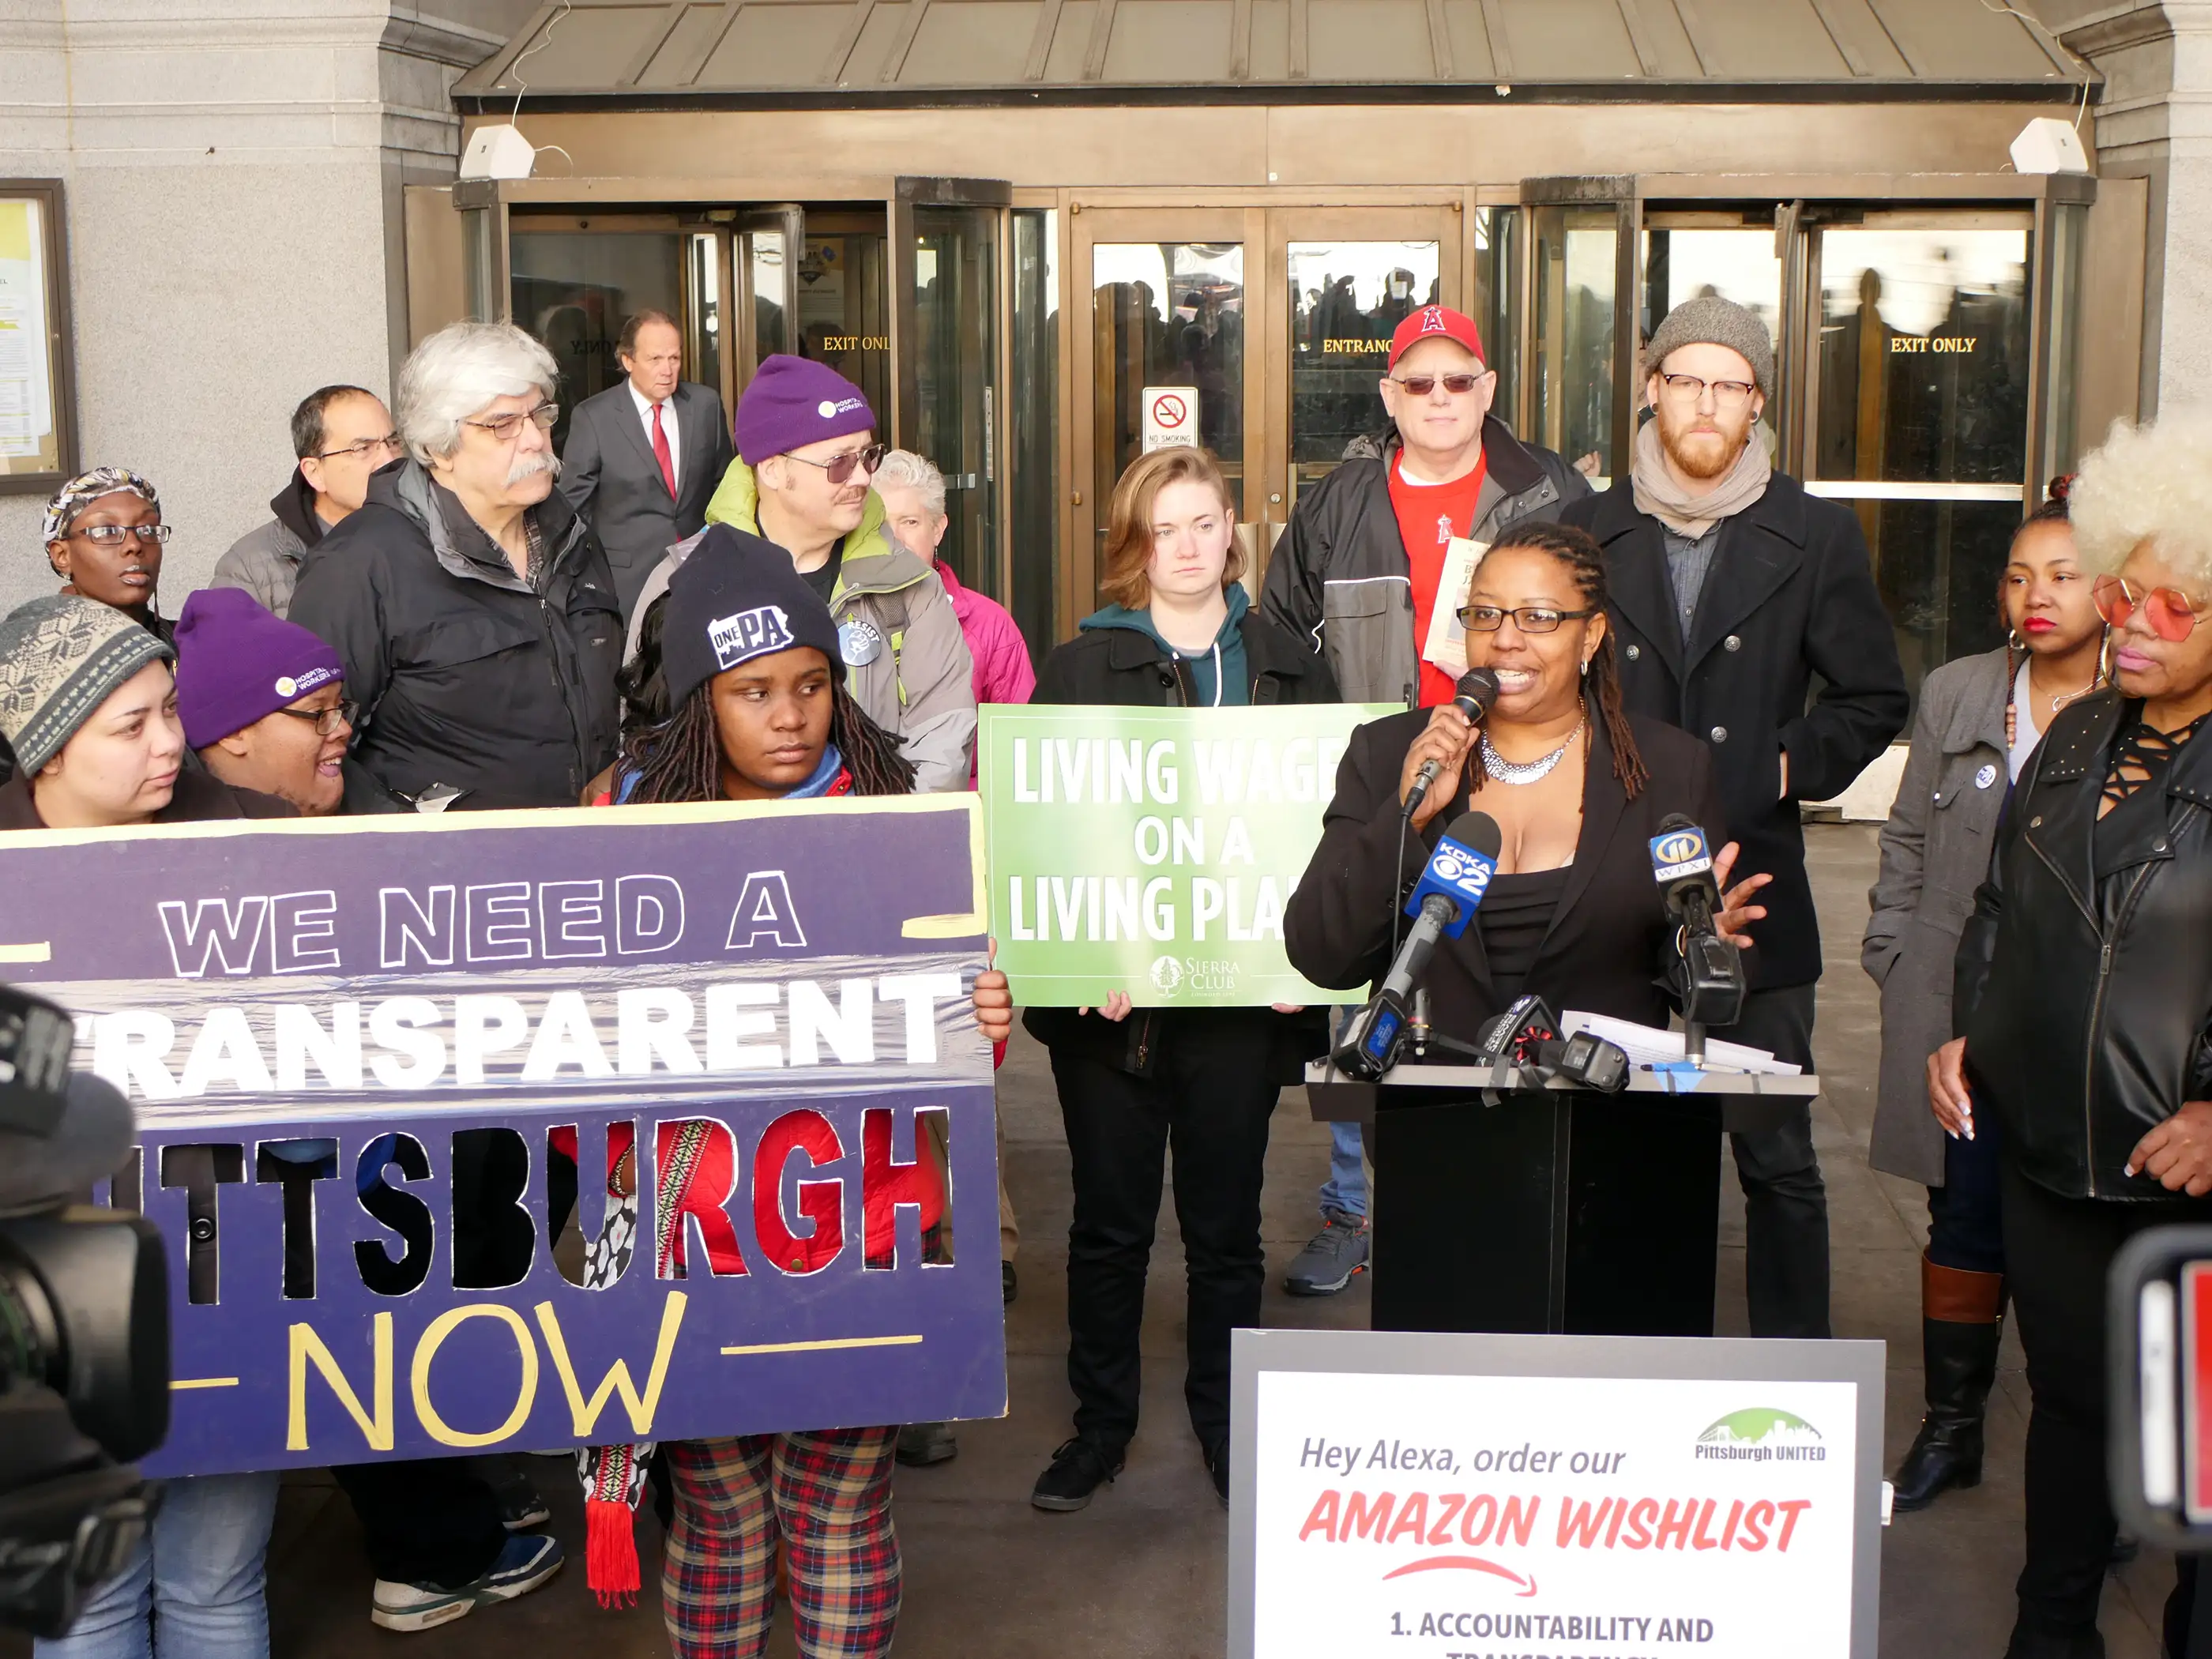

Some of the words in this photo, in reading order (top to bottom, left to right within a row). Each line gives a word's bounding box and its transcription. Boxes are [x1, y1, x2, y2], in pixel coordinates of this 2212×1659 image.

[824, 337, 858, 350] EXIT
[861, 337, 890, 350] ONL
[1323, 340, 1394, 352] ENTRANC
[1890, 337, 1929, 352] EXIT
[1932, 337, 1977, 352] ONLY
[714, 625, 741, 649] ONE
[736, 608, 790, 651] PA
[847, 620, 880, 641] RESIST
[1012, 736, 1179, 805] LIVING
[1192, 735, 1348, 805] WAGE
[1134, 814, 1204, 866] ON
[1219, 815, 1255, 866] A
[1439, 842, 1490, 875] KDKA
[1657, 859, 1708, 877] WPXI
[1457, 867, 1488, 897] 2
[1009, 875, 1176, 942] LIVING
[1191, 874, 1300, 942] PLA
[158, 890, 341, 978] WE
[379, 874, 685, 969] NEED
[725, 870, 807, 950] A
[1186, 956, 1240, 974] SIERRA
[1191, 973, 1236, 989] CLUB
[95, 1107, 954, 1306] TTSBURGH
[286, 1291, 688, 1451] NOW
[1299, 1437, 1362, 1477] Hey
[1366, 1439, 1462, 1475] Alexa,
[1473, 1443, 1563, 1473] order
[1569, 1450, 1627, 1474] our
[1695, 1445, 1772, 1462] Pittsburgh
[1776, 1446, 1826, 1461] UNITED
[1298, 1488, 1541, 1548] AMAZON
[1554, 1495, 1811, 1553] WISHLIST
[1390, 1612, 1413, 1636] 1.
[1419, 1612, 1652, 1642] ACCOUNTABILITY
[1656, 1617, 1714, 1642] AND
